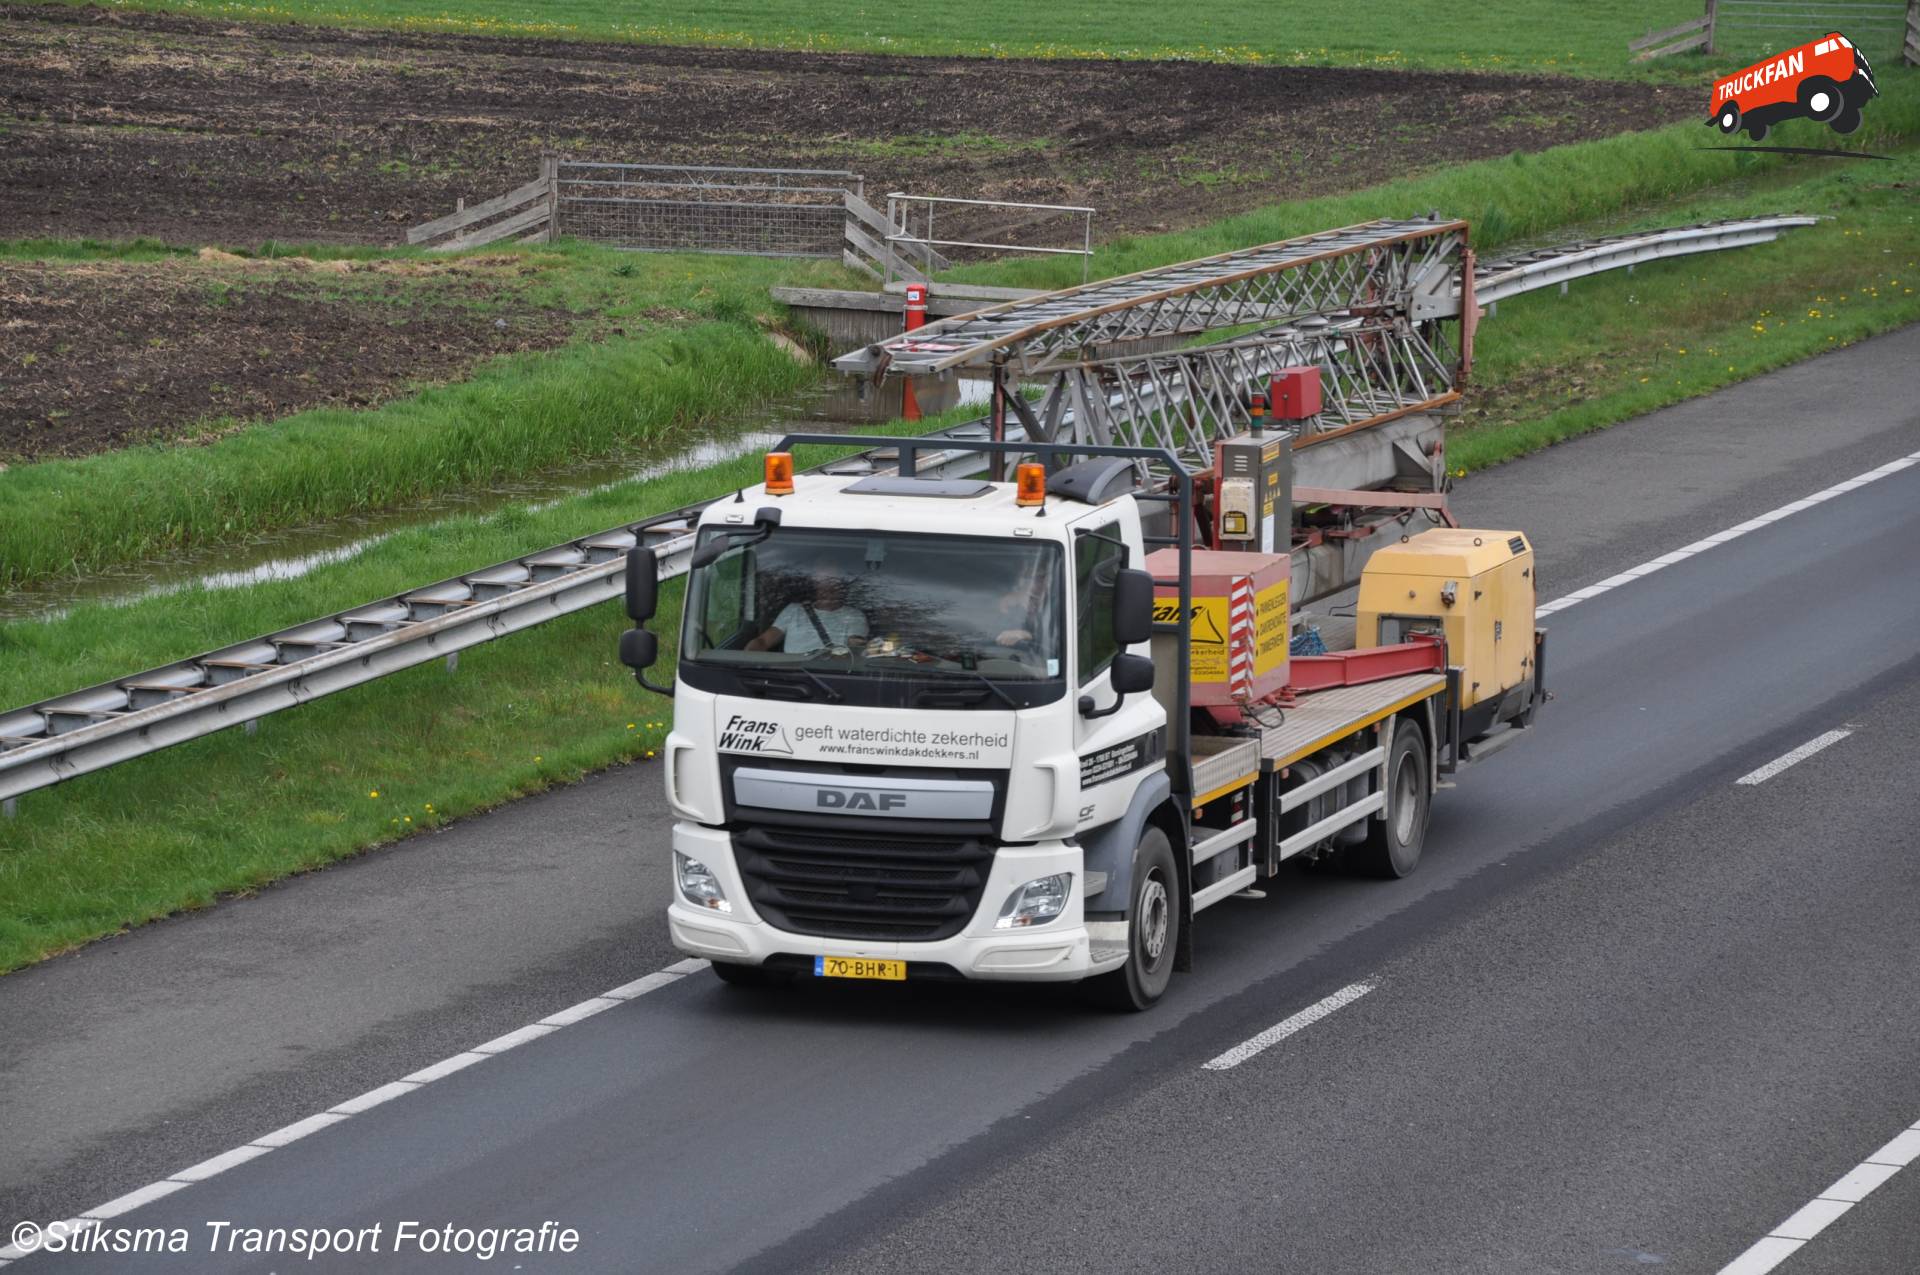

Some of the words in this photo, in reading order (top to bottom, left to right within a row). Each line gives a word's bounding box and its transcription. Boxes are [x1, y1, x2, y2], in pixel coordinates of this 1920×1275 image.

[1152, 603, 1203, 622] rans
[726, 715, 778, 735] Frans
[718, 732, 764, 751] Wink
[795, 725, 833, 742] geeft
[838, 728, 927, 744] waterdichte
[931, 731, 1008, 748] zekerheid
[819, 743, 979, 760] www.franswinkdakdekkers.nl
[816, 789, 907, 811] DAF
[1080, 804, 1096, 817] CF
[829, 959, 899, 977] 70-BHR-1
